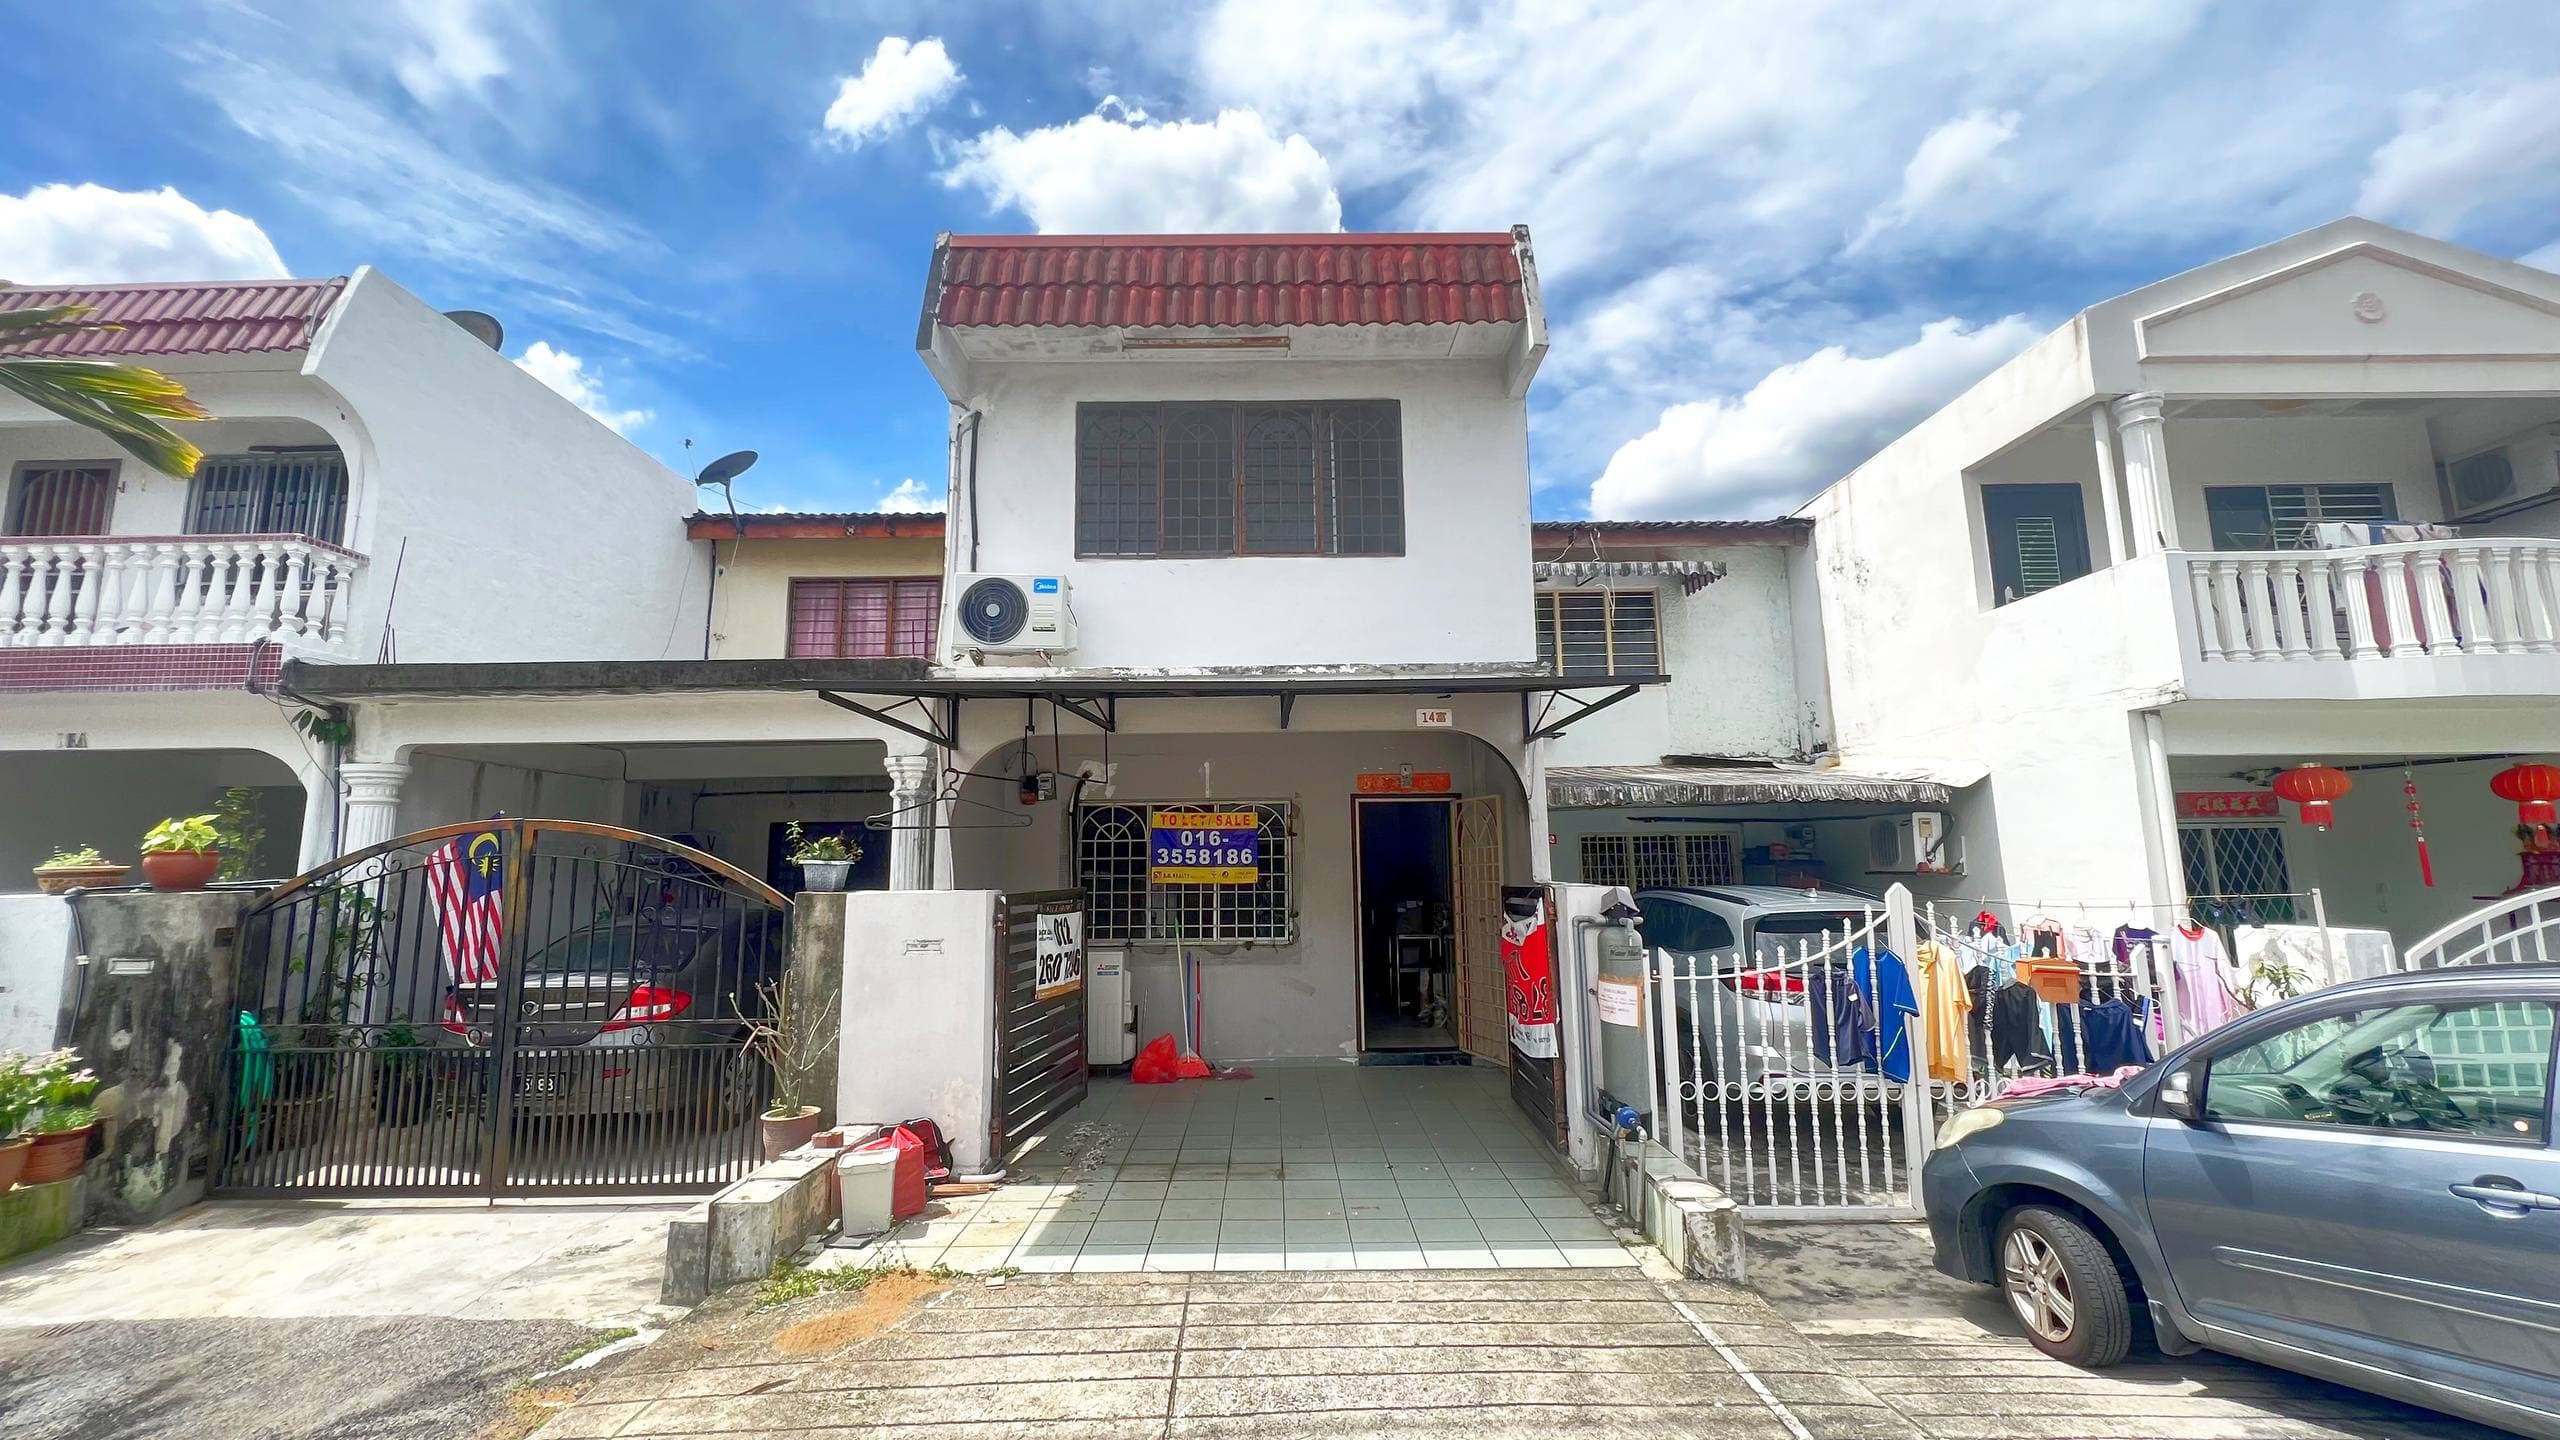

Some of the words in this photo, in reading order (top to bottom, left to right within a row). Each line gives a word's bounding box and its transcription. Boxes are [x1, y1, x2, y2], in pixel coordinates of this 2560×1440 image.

[1160, 815, 1177, 826] TO
[1181, 830, 1229, 846] 016-
[1157, 848, 1253, 865] 3558186
[1053, 917, 1073, 947] 012
[1038, 953, 1063, 985] 260
